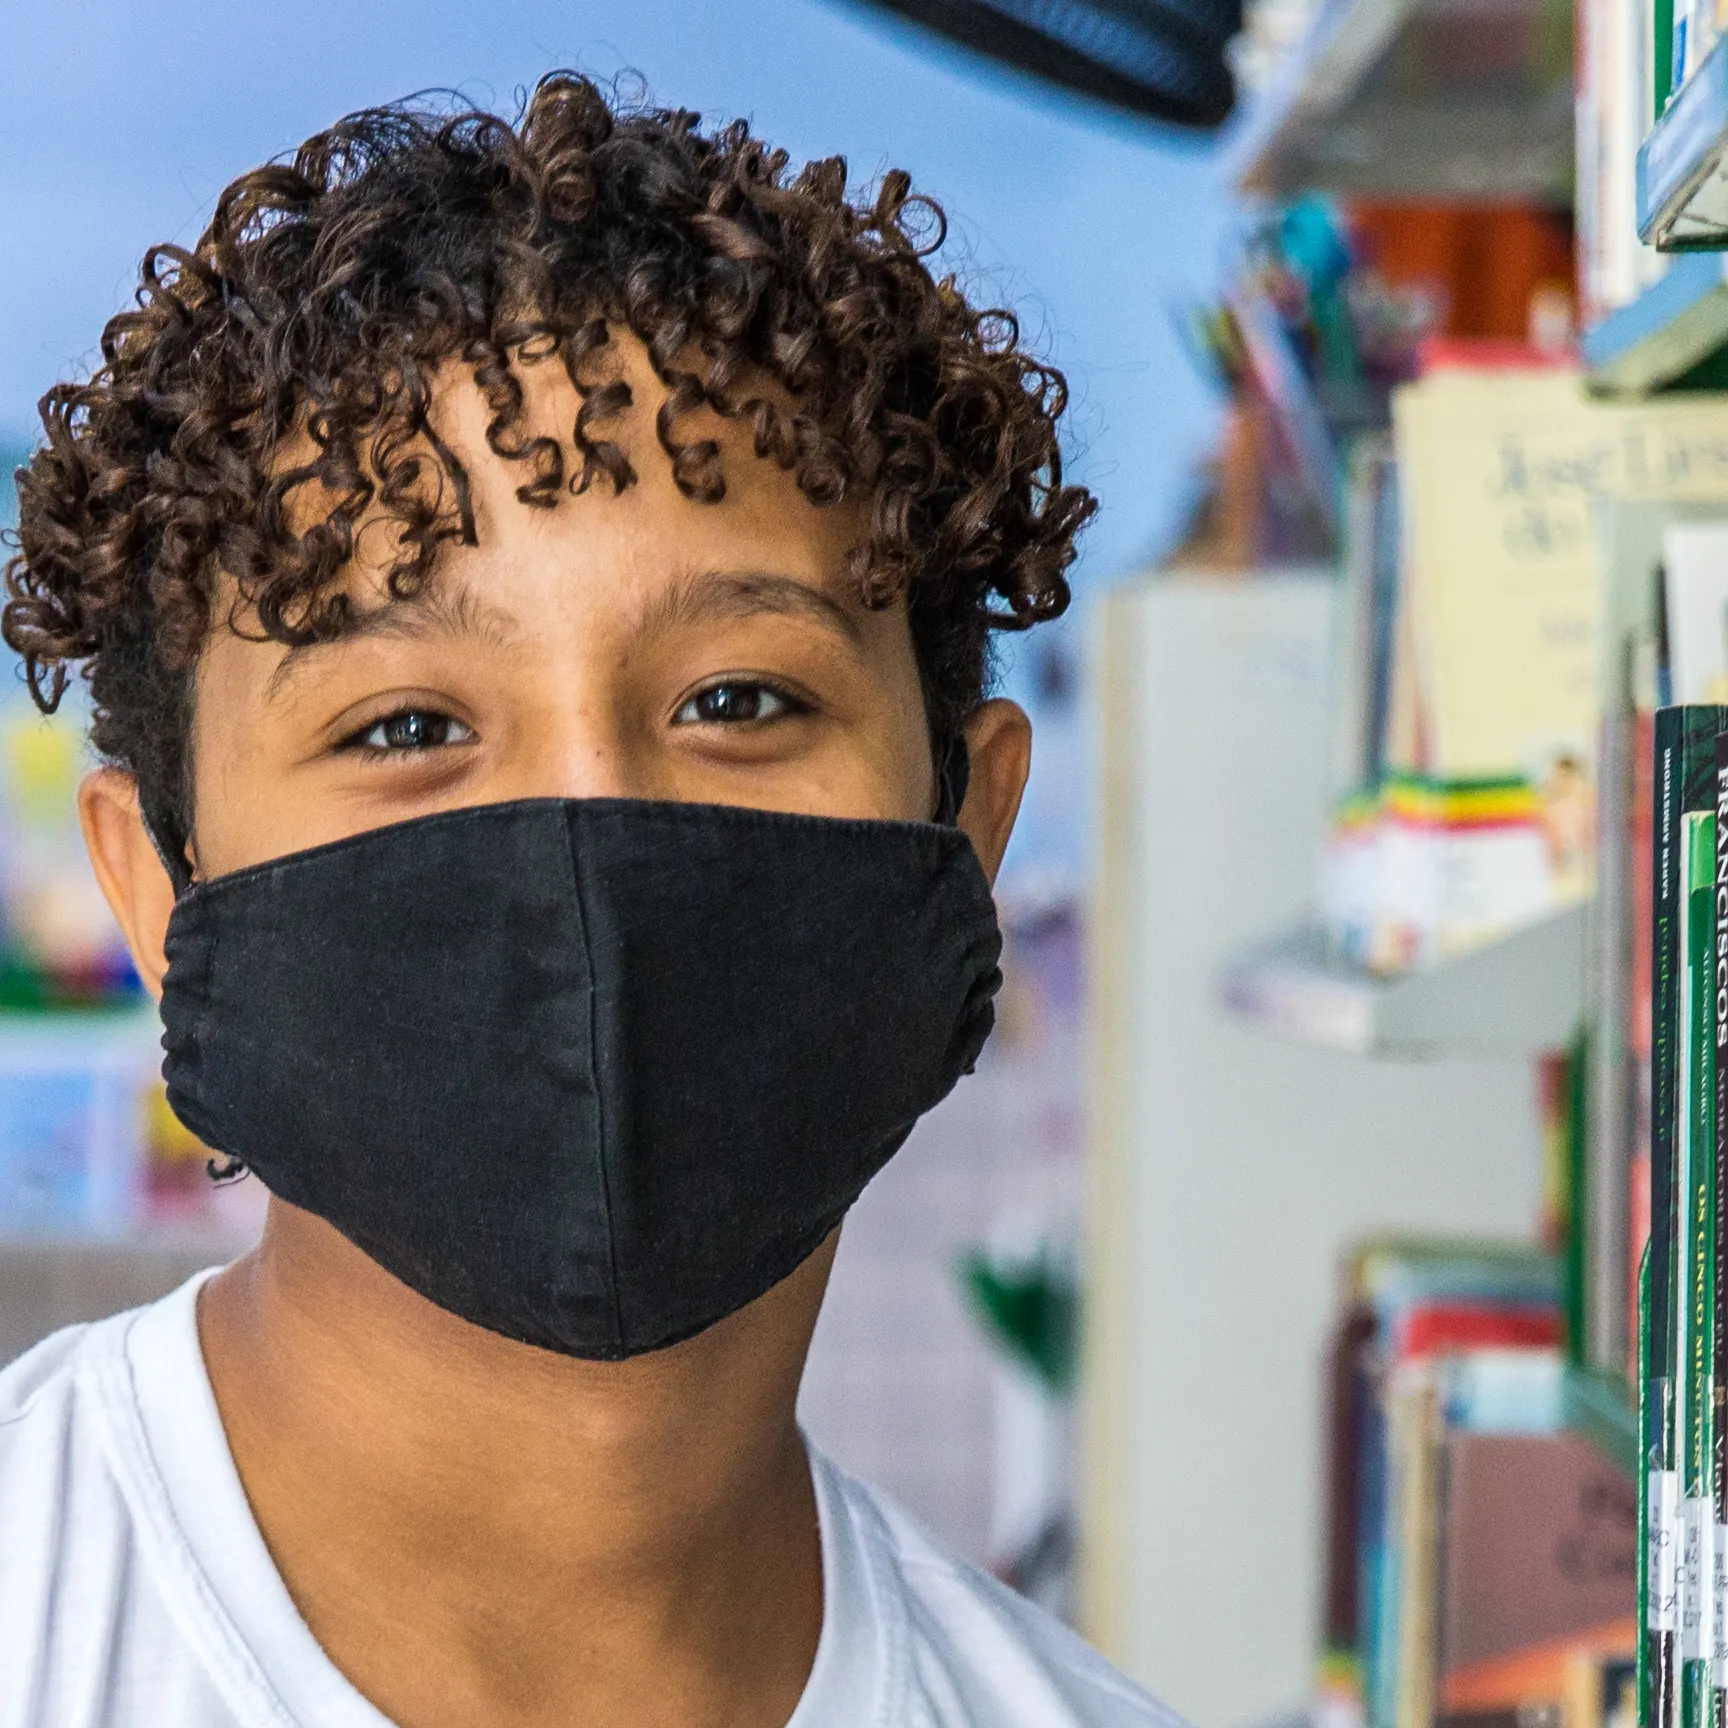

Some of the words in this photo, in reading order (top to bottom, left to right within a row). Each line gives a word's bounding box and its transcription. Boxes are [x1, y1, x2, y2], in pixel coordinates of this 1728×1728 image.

[1661, 747, 1672, 844] ARMSTRONG
[1660, 847, 1670, 900] KAREN
[1715, 1067, 1727, 1247] MORADORES
[1696, 1230, 1706, 1326] CINCO
